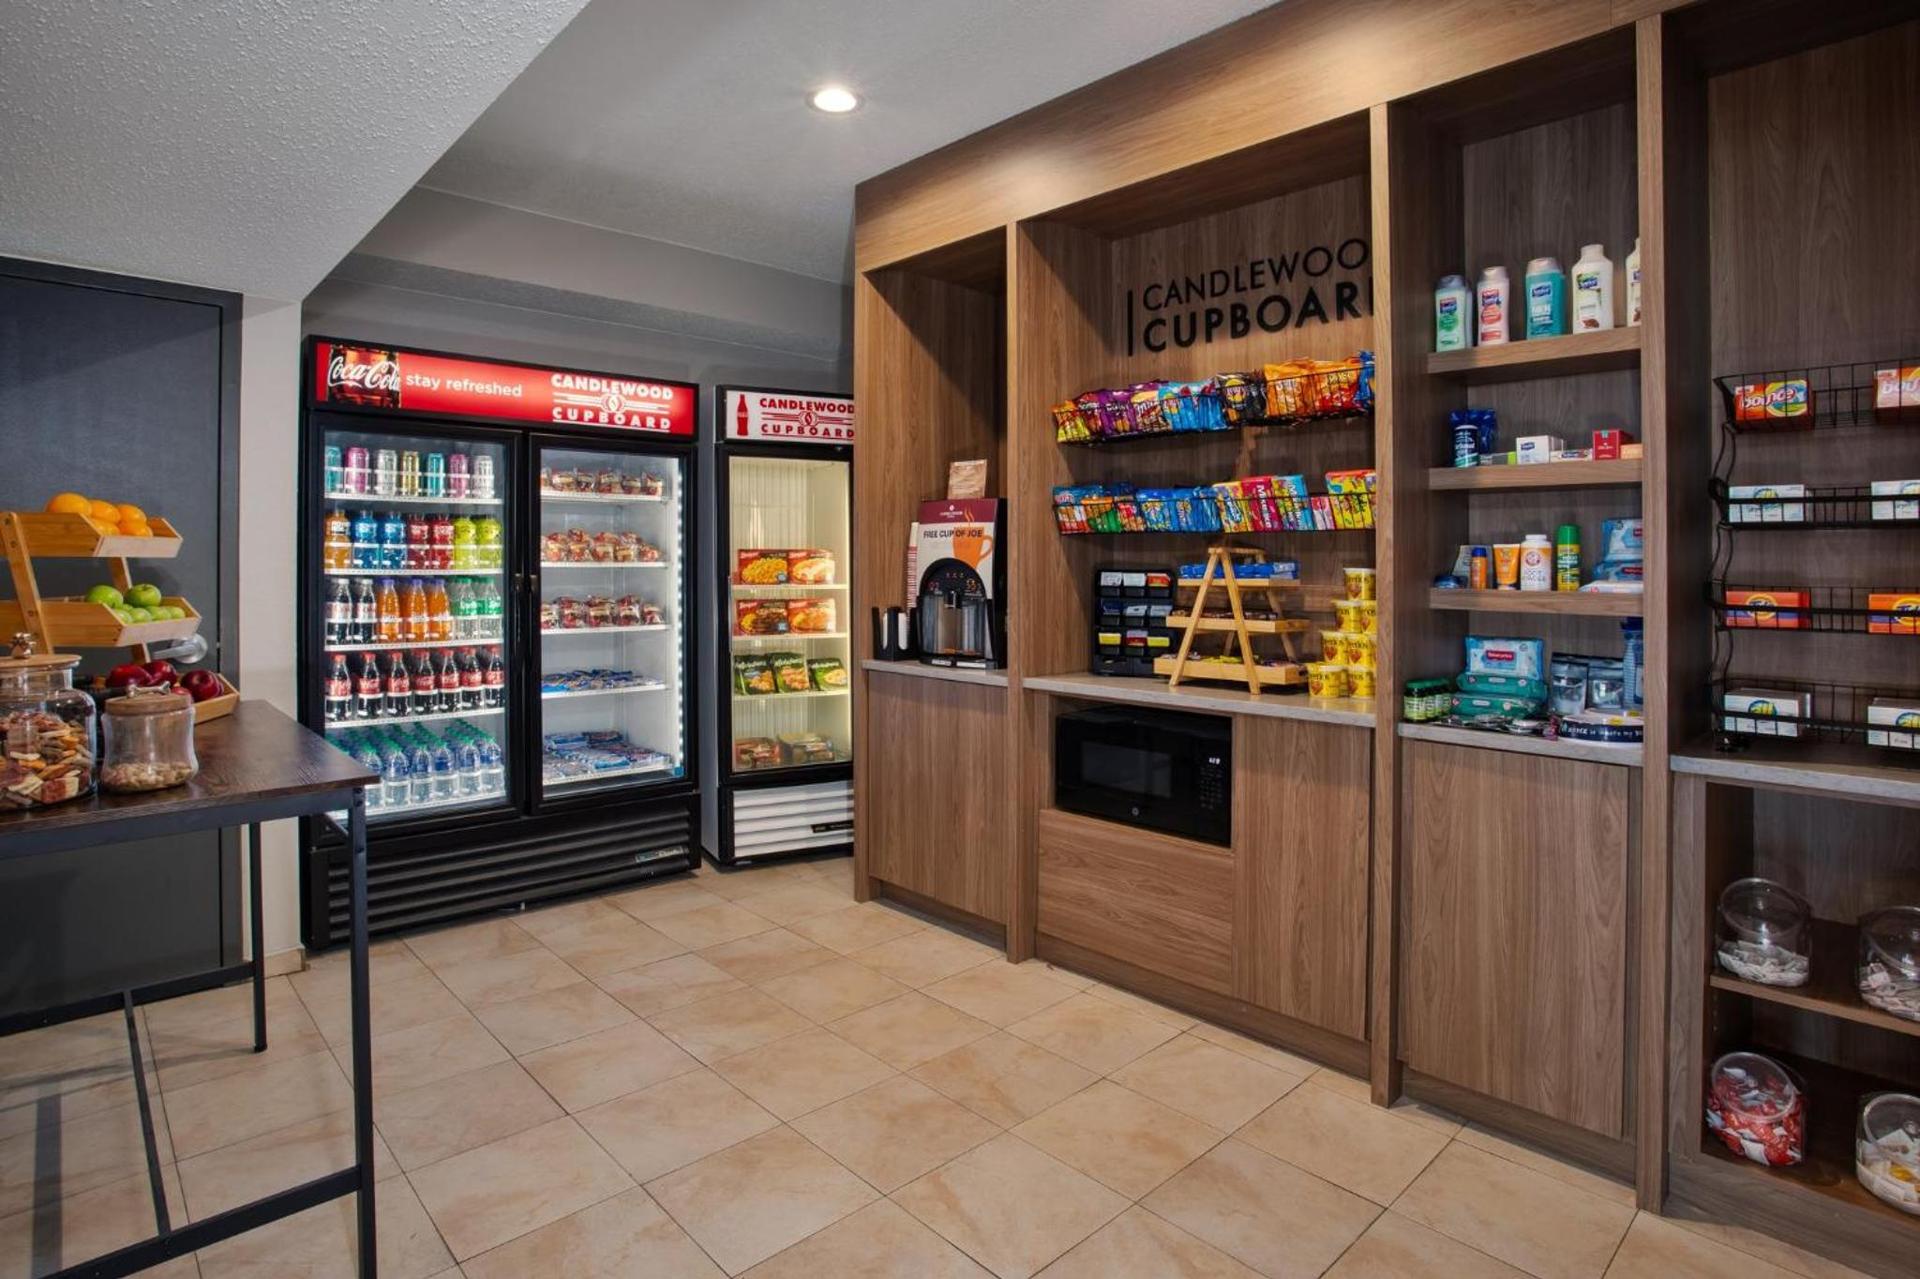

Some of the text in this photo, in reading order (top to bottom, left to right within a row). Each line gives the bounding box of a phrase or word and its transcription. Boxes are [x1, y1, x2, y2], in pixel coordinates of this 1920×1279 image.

[1143, 238, 1370, 312] CANDLEWOO
[1143, 275, 1374, 353] CUPBOAR
[406, 373, 523, 397] stay refreshed
[551, 374, 674, 401] CANDLEWOOD
[759, 398, 855, 414] CANDLEWOOD
[552, 407, 671, 430] CUPBOARD
[761, 424, 855, 438] CUPBOARD
[923, 529, 983, 539] FREE CUP OF JOE
